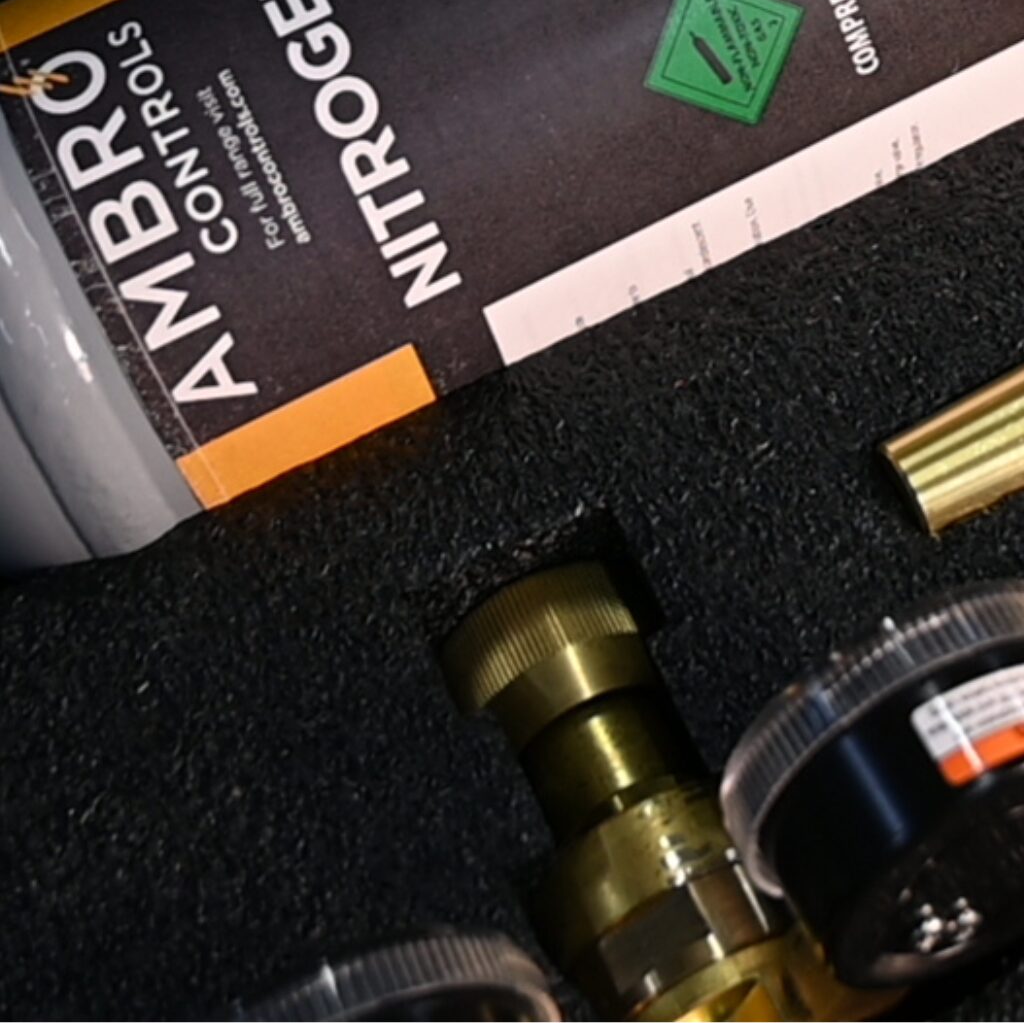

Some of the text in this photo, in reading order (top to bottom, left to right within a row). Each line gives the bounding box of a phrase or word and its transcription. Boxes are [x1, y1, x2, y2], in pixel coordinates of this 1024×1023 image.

[30, 51, 258, 404] AMBRO
[109, 22, 238, 254] CONTROLS
[197, 86, 285, 249] For full range visit
[219, 69, 311, 244] ambrocontrols.com
